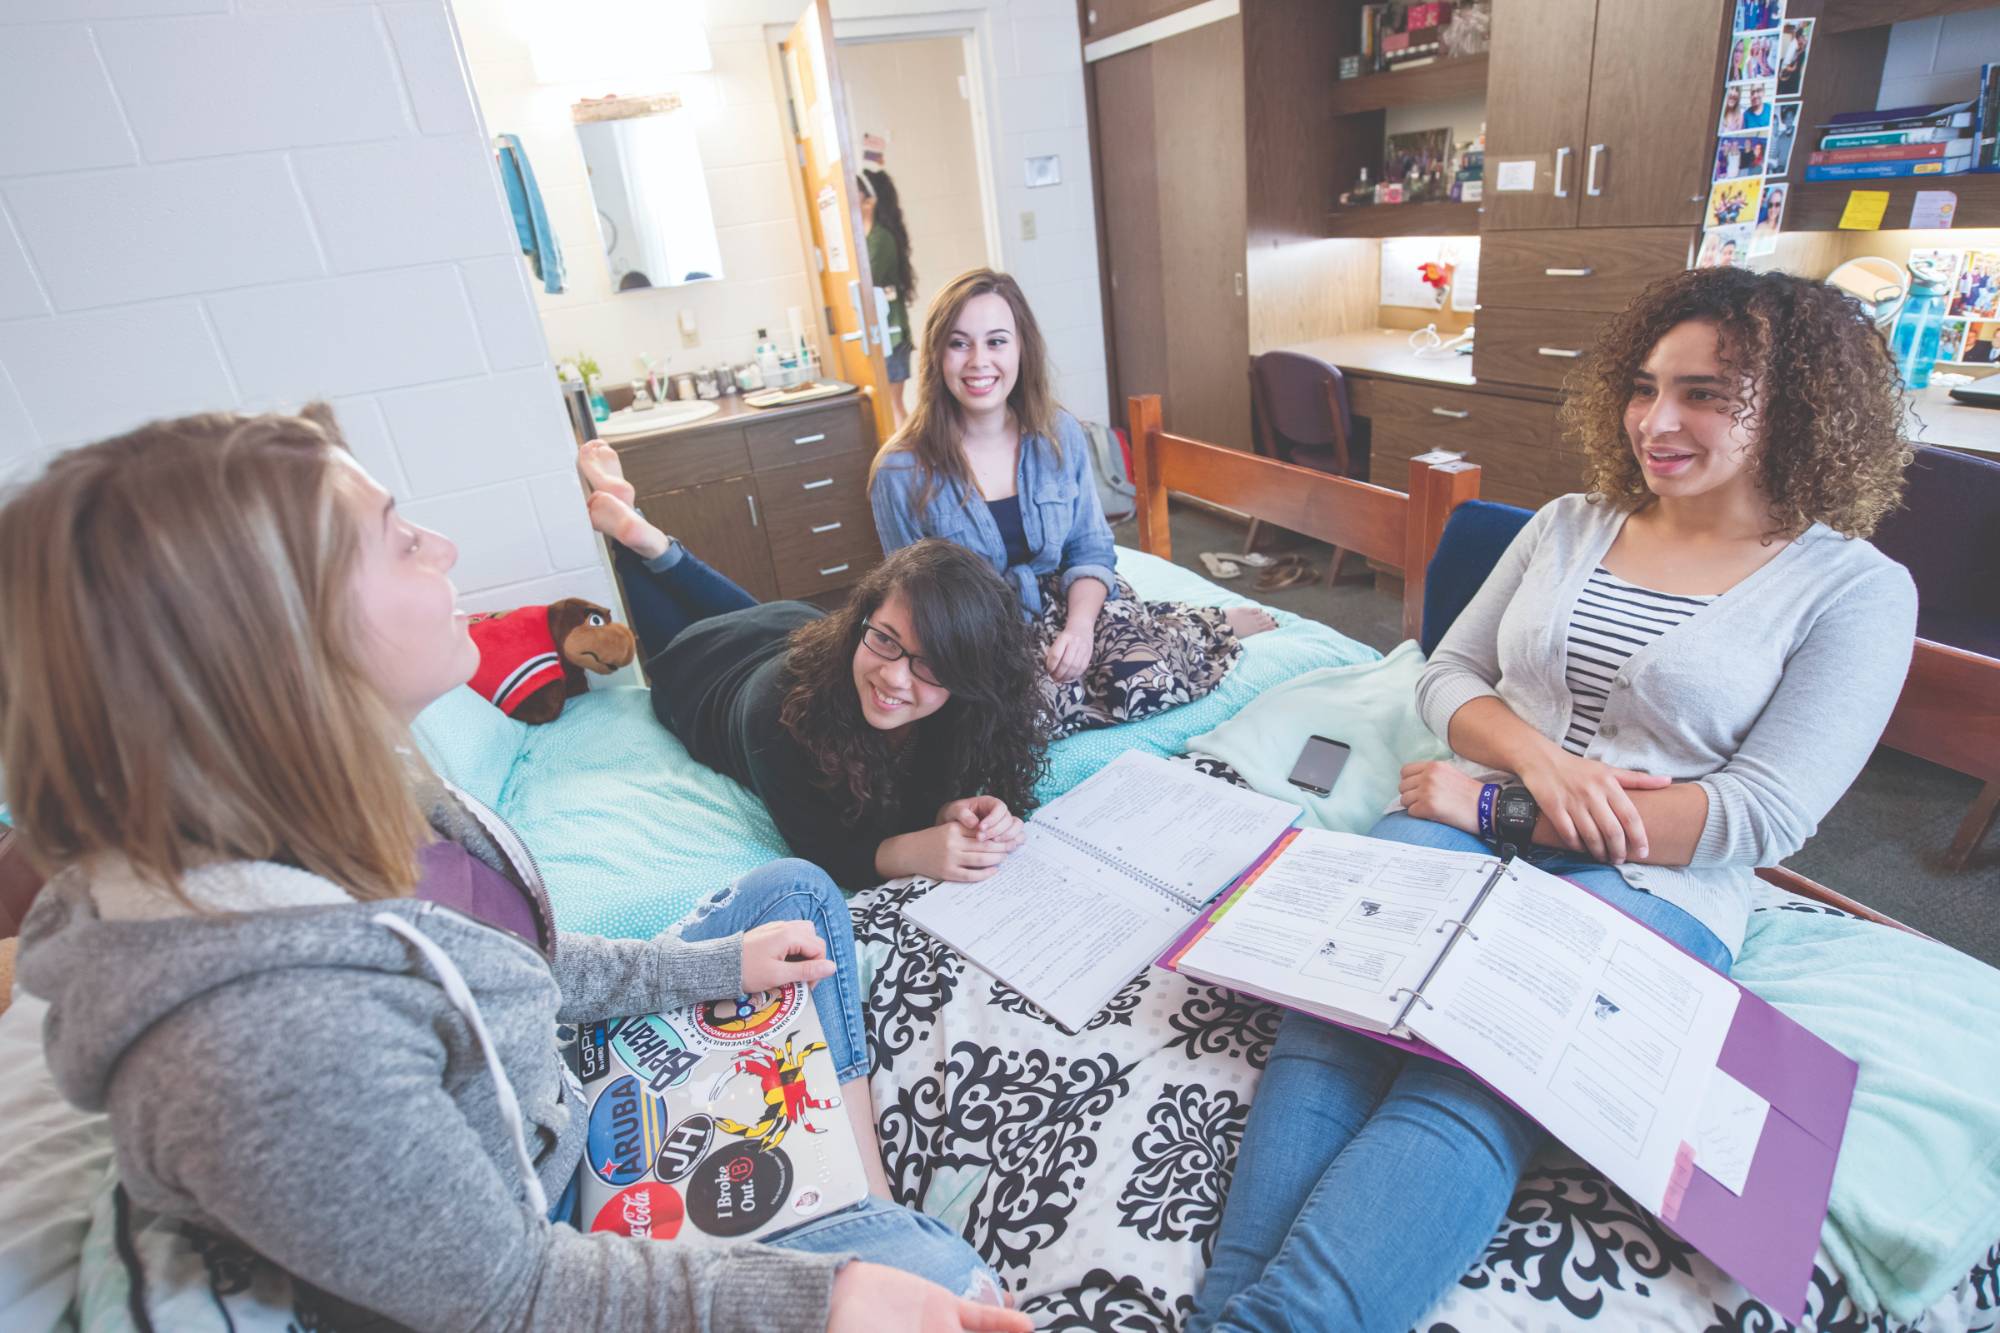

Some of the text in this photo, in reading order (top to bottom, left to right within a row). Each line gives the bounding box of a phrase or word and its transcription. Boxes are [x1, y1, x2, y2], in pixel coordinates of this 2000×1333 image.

[611, 1080, 642, 1174] ARUBA
[662, 1126, 705, 1172] JH
[715, 1166, 732, 1208] Broke
[740, 1179, 756, 1212] Out.
